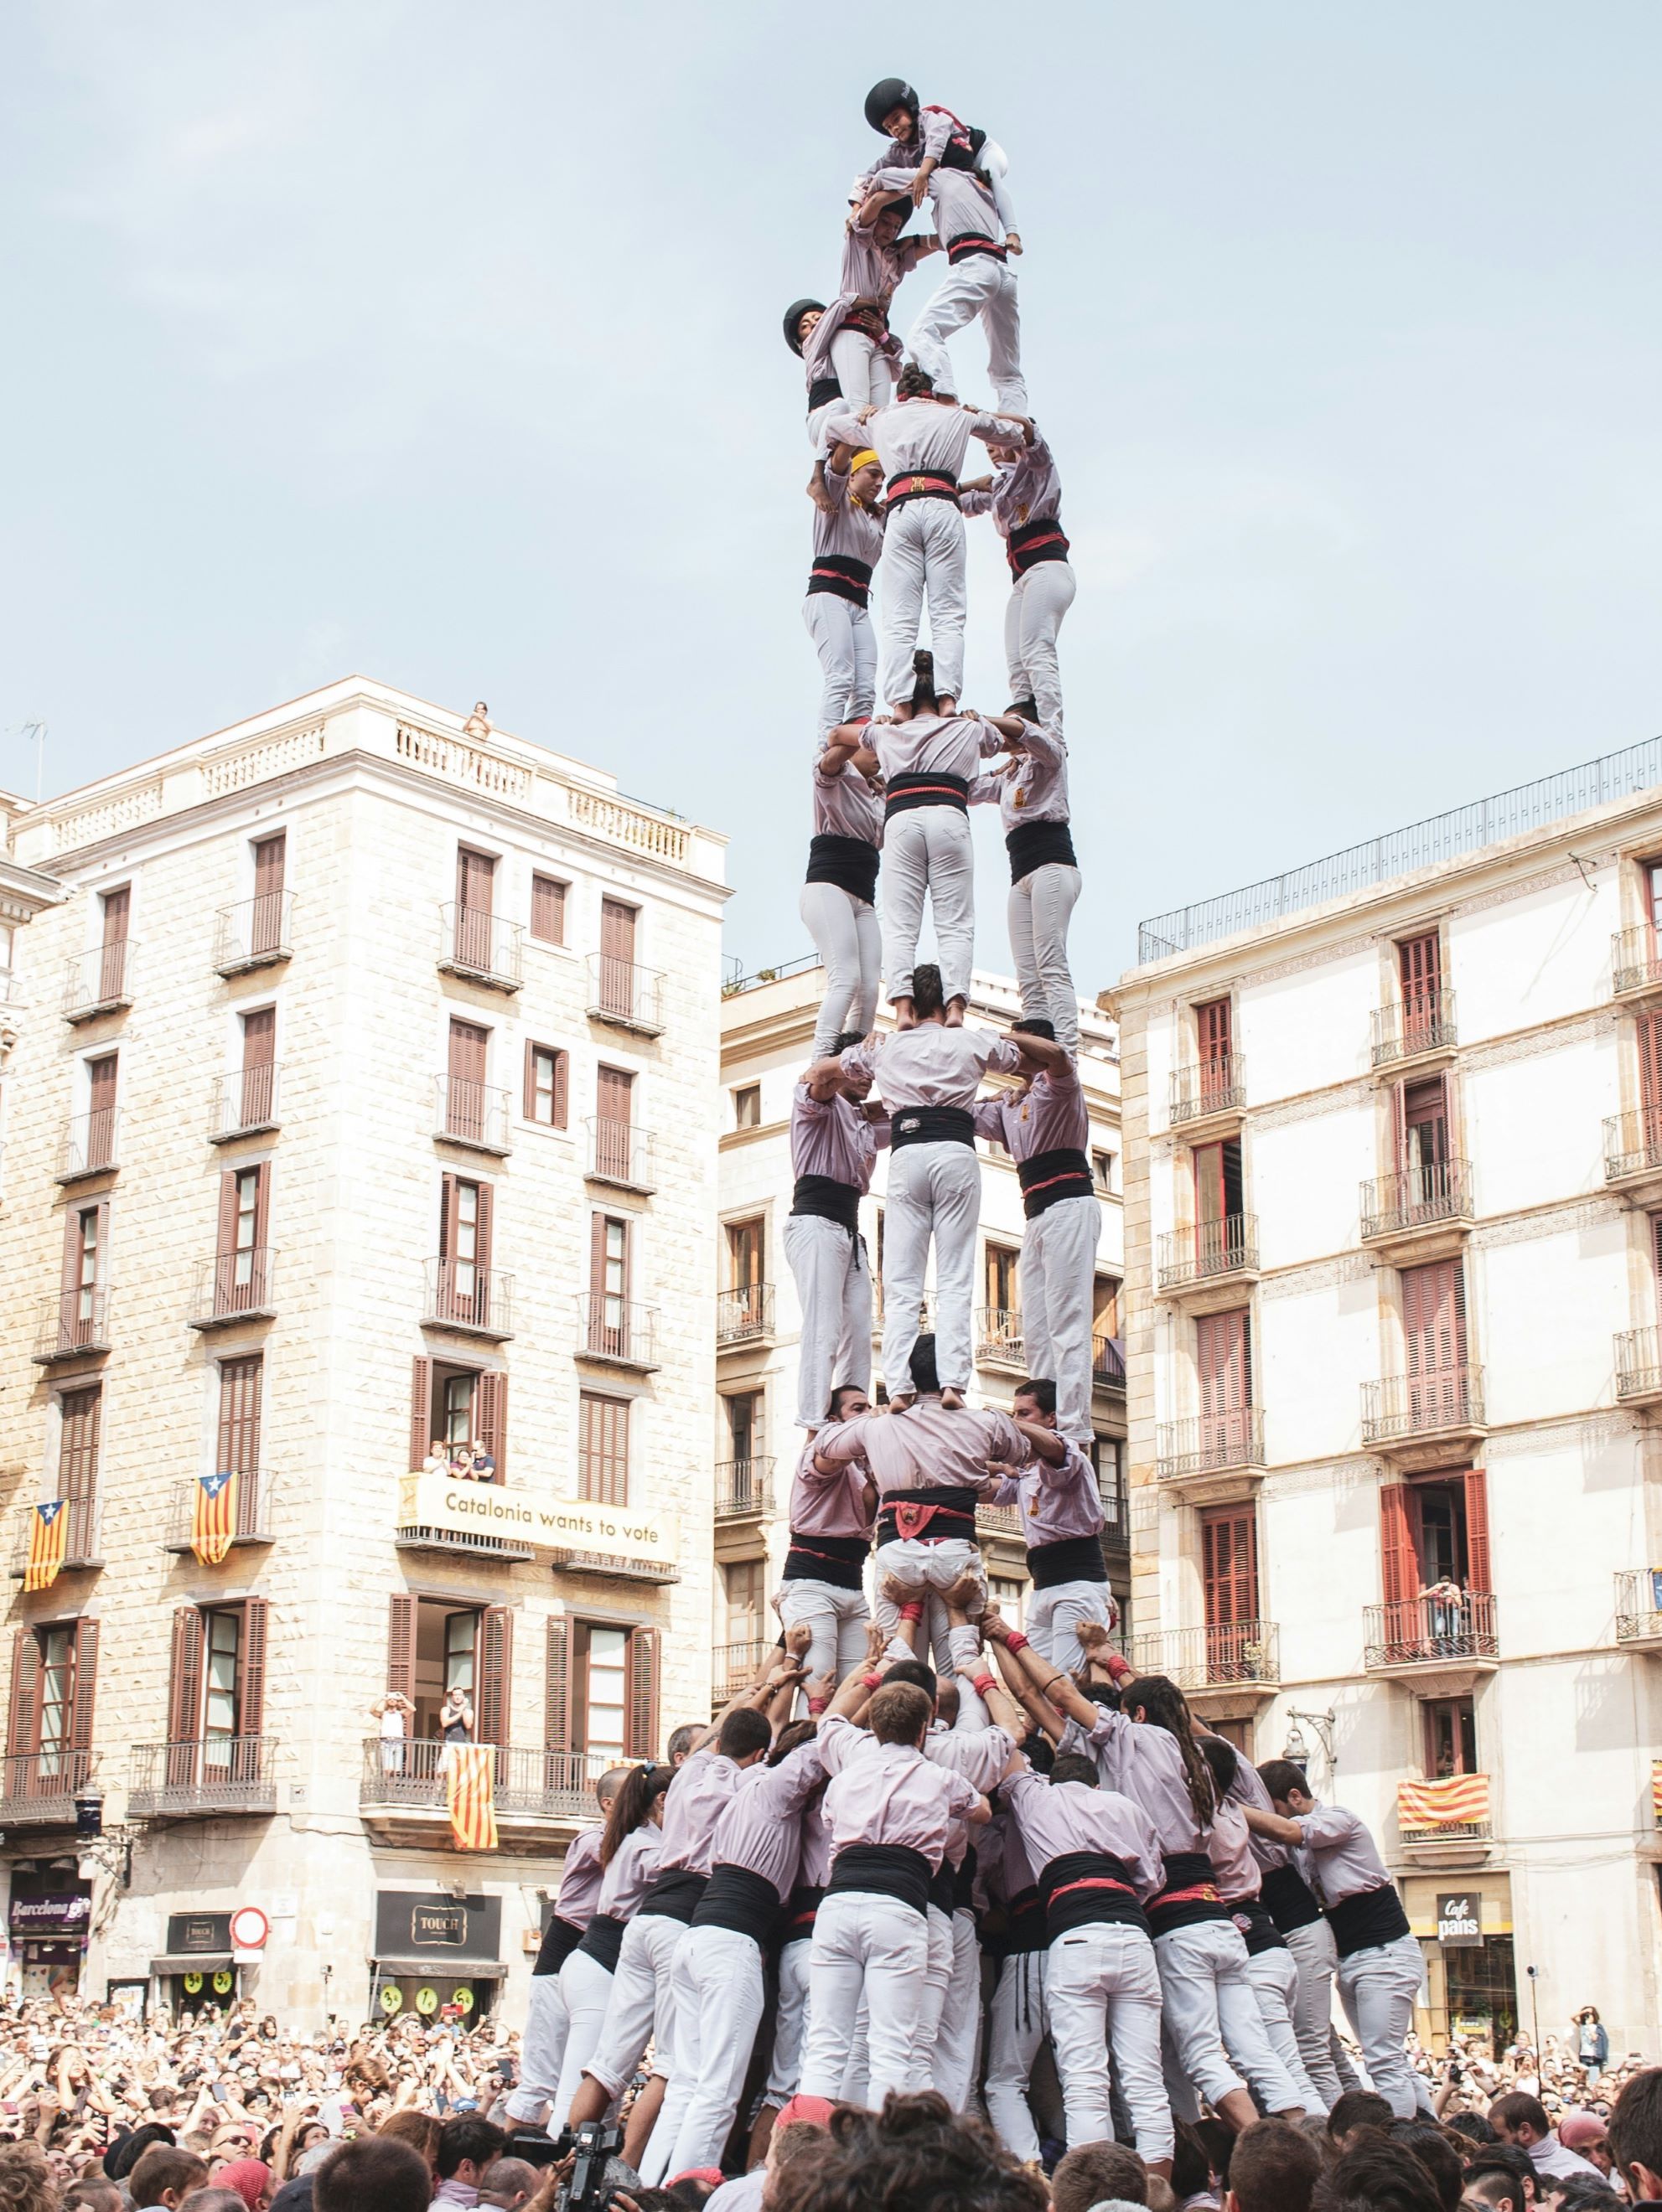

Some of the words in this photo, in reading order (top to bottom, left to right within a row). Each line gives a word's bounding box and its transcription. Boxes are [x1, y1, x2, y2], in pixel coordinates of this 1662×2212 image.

[446, 1493, 532, 1522] Catalonia
[540, 1512, 593, 1532] wants
[600, 1520, 616, 1537] to
[623, 1526, 659, 1543] vote
[12, 1899, 68, 1916] Barcelona
[421, 1917, 459, 1930] TOUCH
[1438, 1919, 1478, 1941] pans
